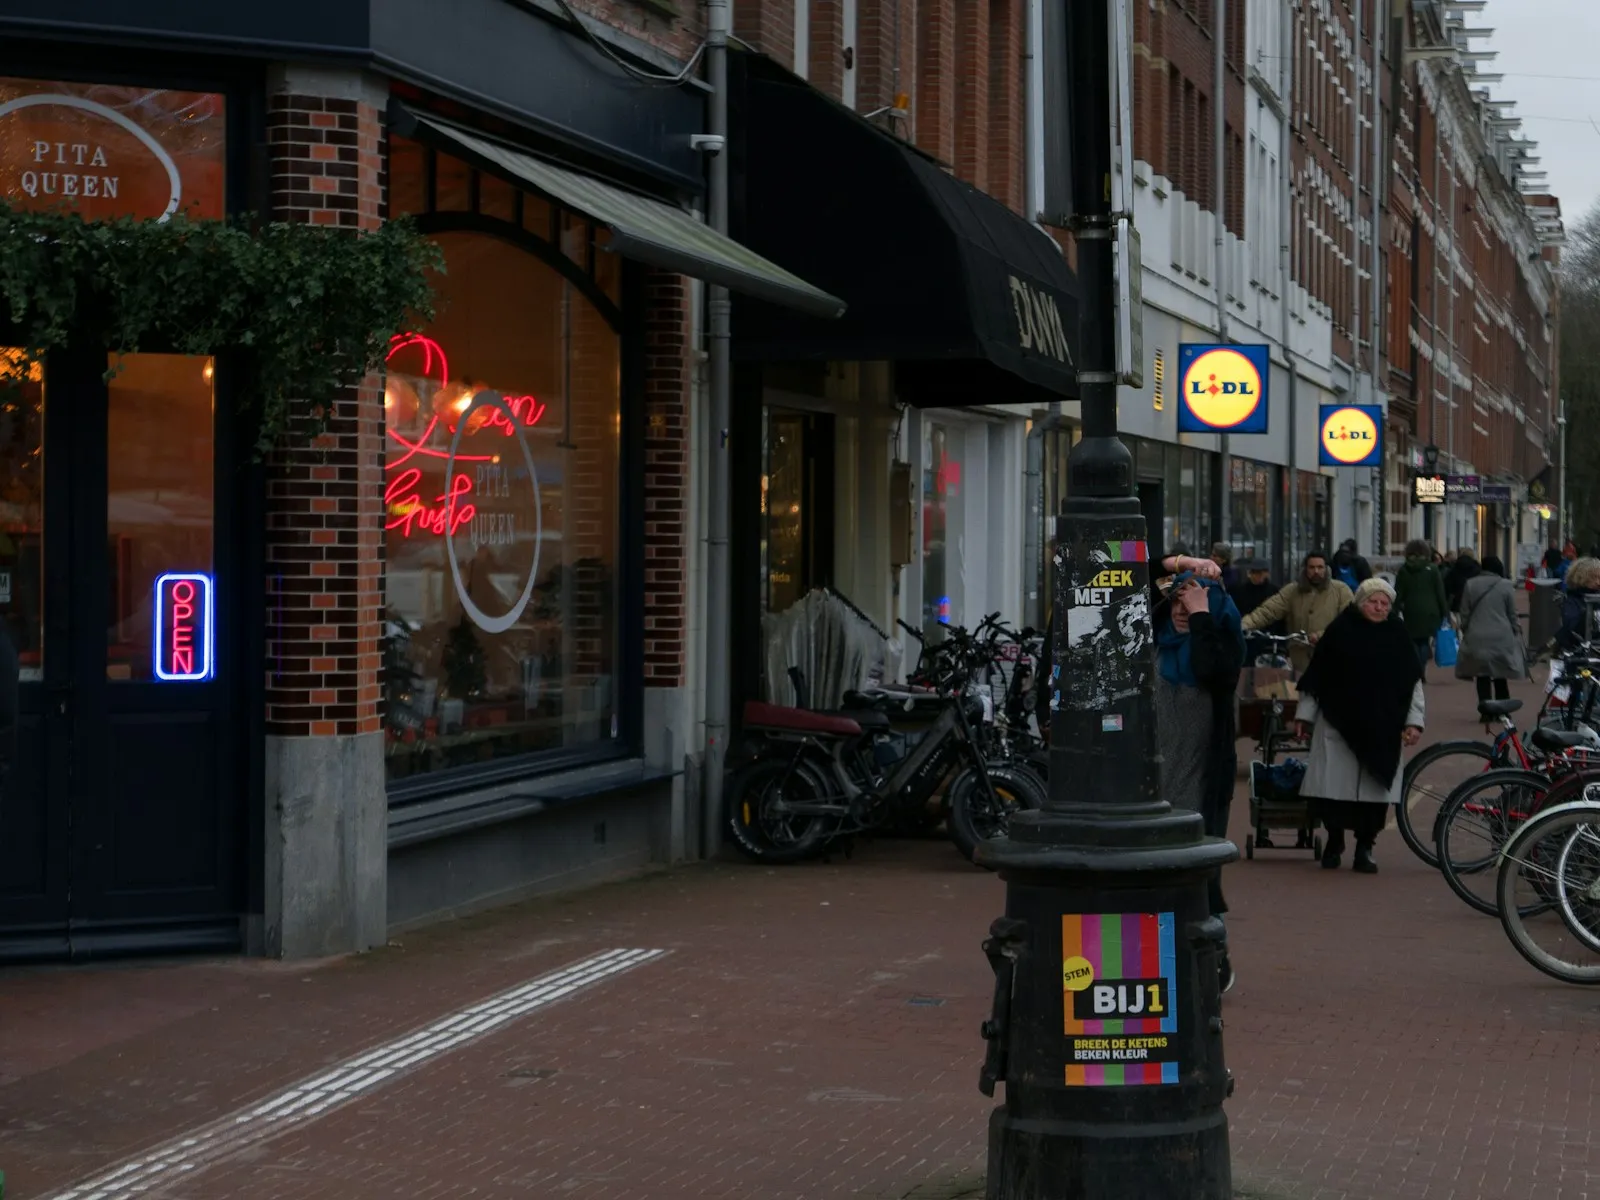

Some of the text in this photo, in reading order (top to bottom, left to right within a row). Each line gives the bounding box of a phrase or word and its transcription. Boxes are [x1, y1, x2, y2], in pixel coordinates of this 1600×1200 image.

[34, 140, 108, 168] PITA
[20, 169, 120, 200] QUEEN
[475, 464, 511, 498] PITA
[469, 512, 516, 550] QUEEN
[1074, 587, 1114, 605] MET
[171, 580, 194, 675] OPEN
[1064, 966, 1091, 982] STEM
[1092, 984, 1164, 1015] BIJ1
[1073, 1036, 1169, 1049] BREEK DE KETENS
[1073, 1048, 1149, 1061] BEKEN KLEUR
